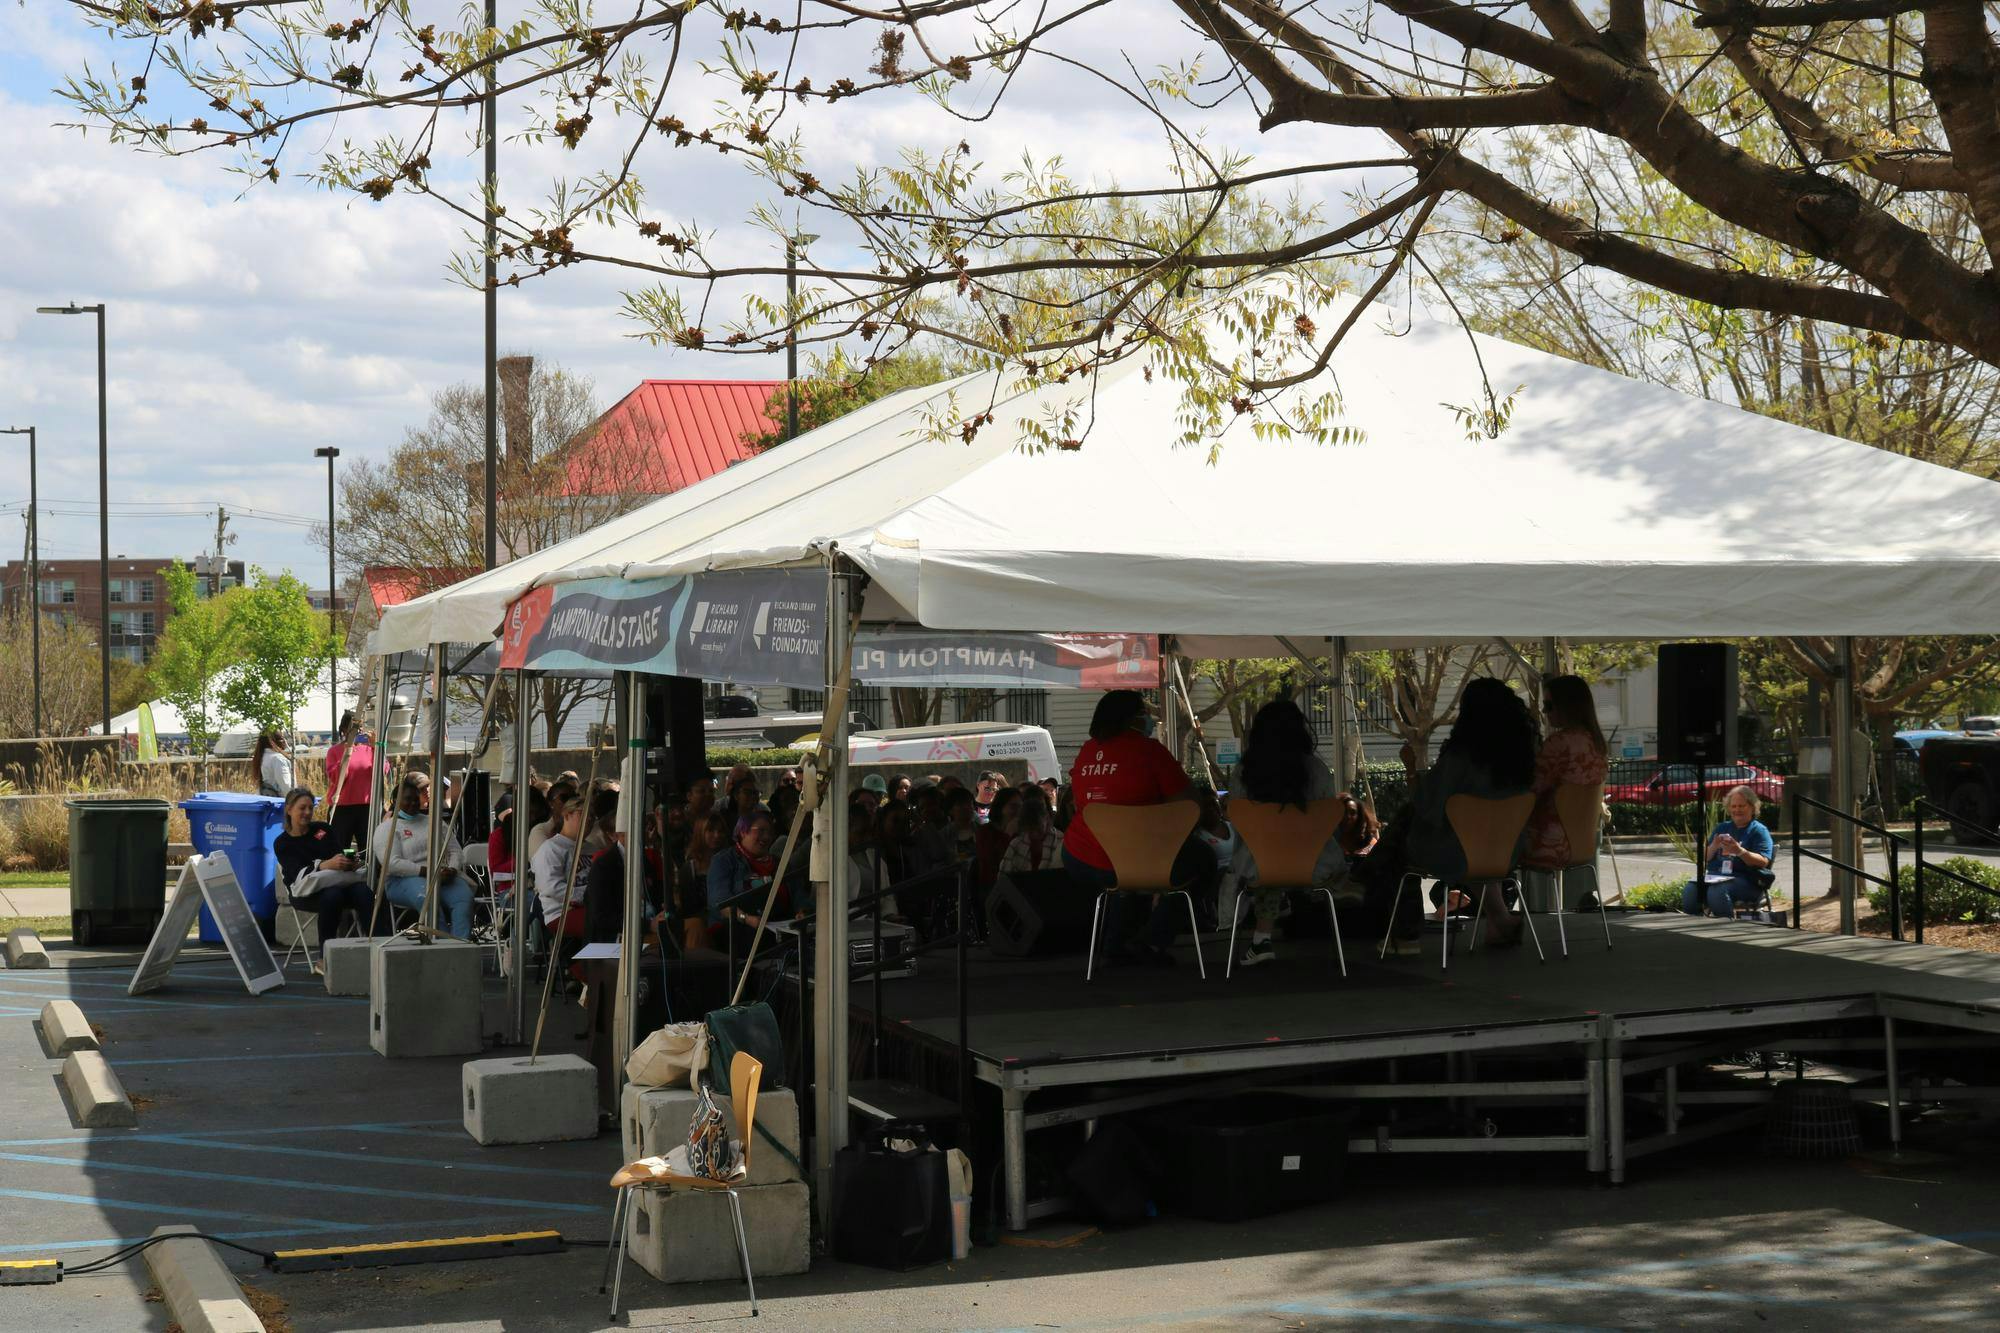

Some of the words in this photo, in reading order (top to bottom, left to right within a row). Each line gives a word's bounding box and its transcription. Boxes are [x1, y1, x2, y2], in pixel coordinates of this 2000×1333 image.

[711, 603, 739, 615] RICHLAND
[547, 607, 594, 641] HAMPTON
[589, 613, 616, 648] AZA
[616, 605, 662, 649] STAGE
[705, 618, 739, 635] LIBRARY
[1081, 763, 1118, 777] STAFF
